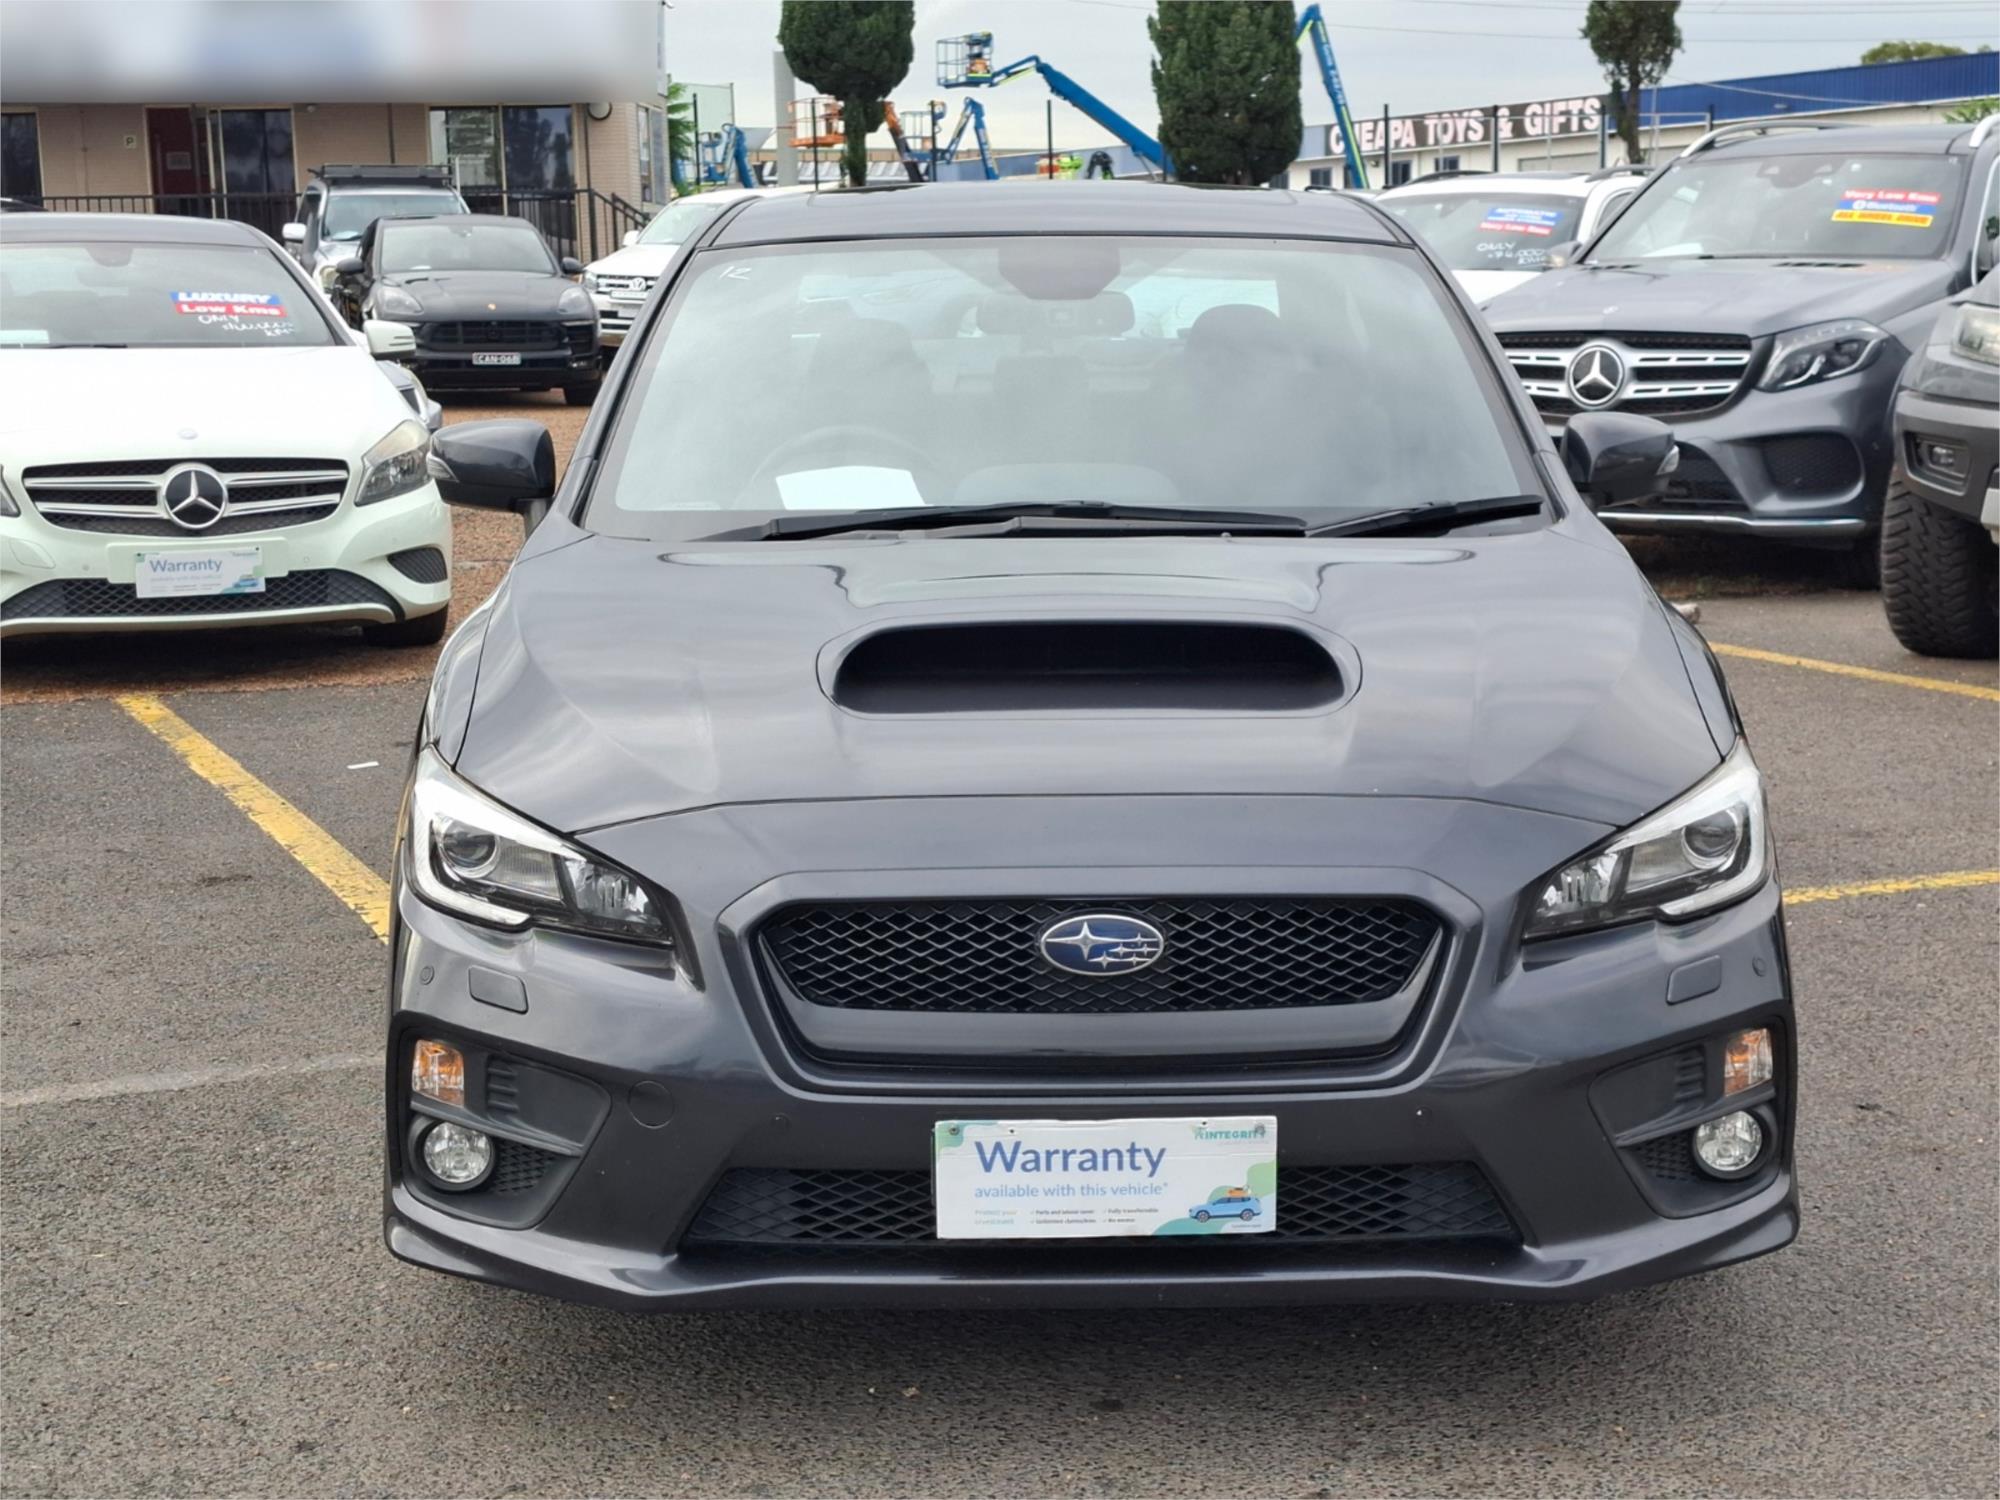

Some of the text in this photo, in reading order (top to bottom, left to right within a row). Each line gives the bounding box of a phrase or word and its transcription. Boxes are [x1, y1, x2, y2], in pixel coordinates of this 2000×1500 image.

[1424, 110, 1484, 145] TOYS
[1497, 107, 1513, 140] &
[1524, 98, 1601, 137] GIFTS
[178, 291, 272, 304] LUXURY
[181, 303, 226, 314] Low
[149, 560, 223, 573] Warranty
[974, 1140, 1167, 1178] Warranty
[975, 1184, 1039, 1198] available
[1043, 1184, 1076, 1198] with
[1080, 1183, 1107, 1197] this
